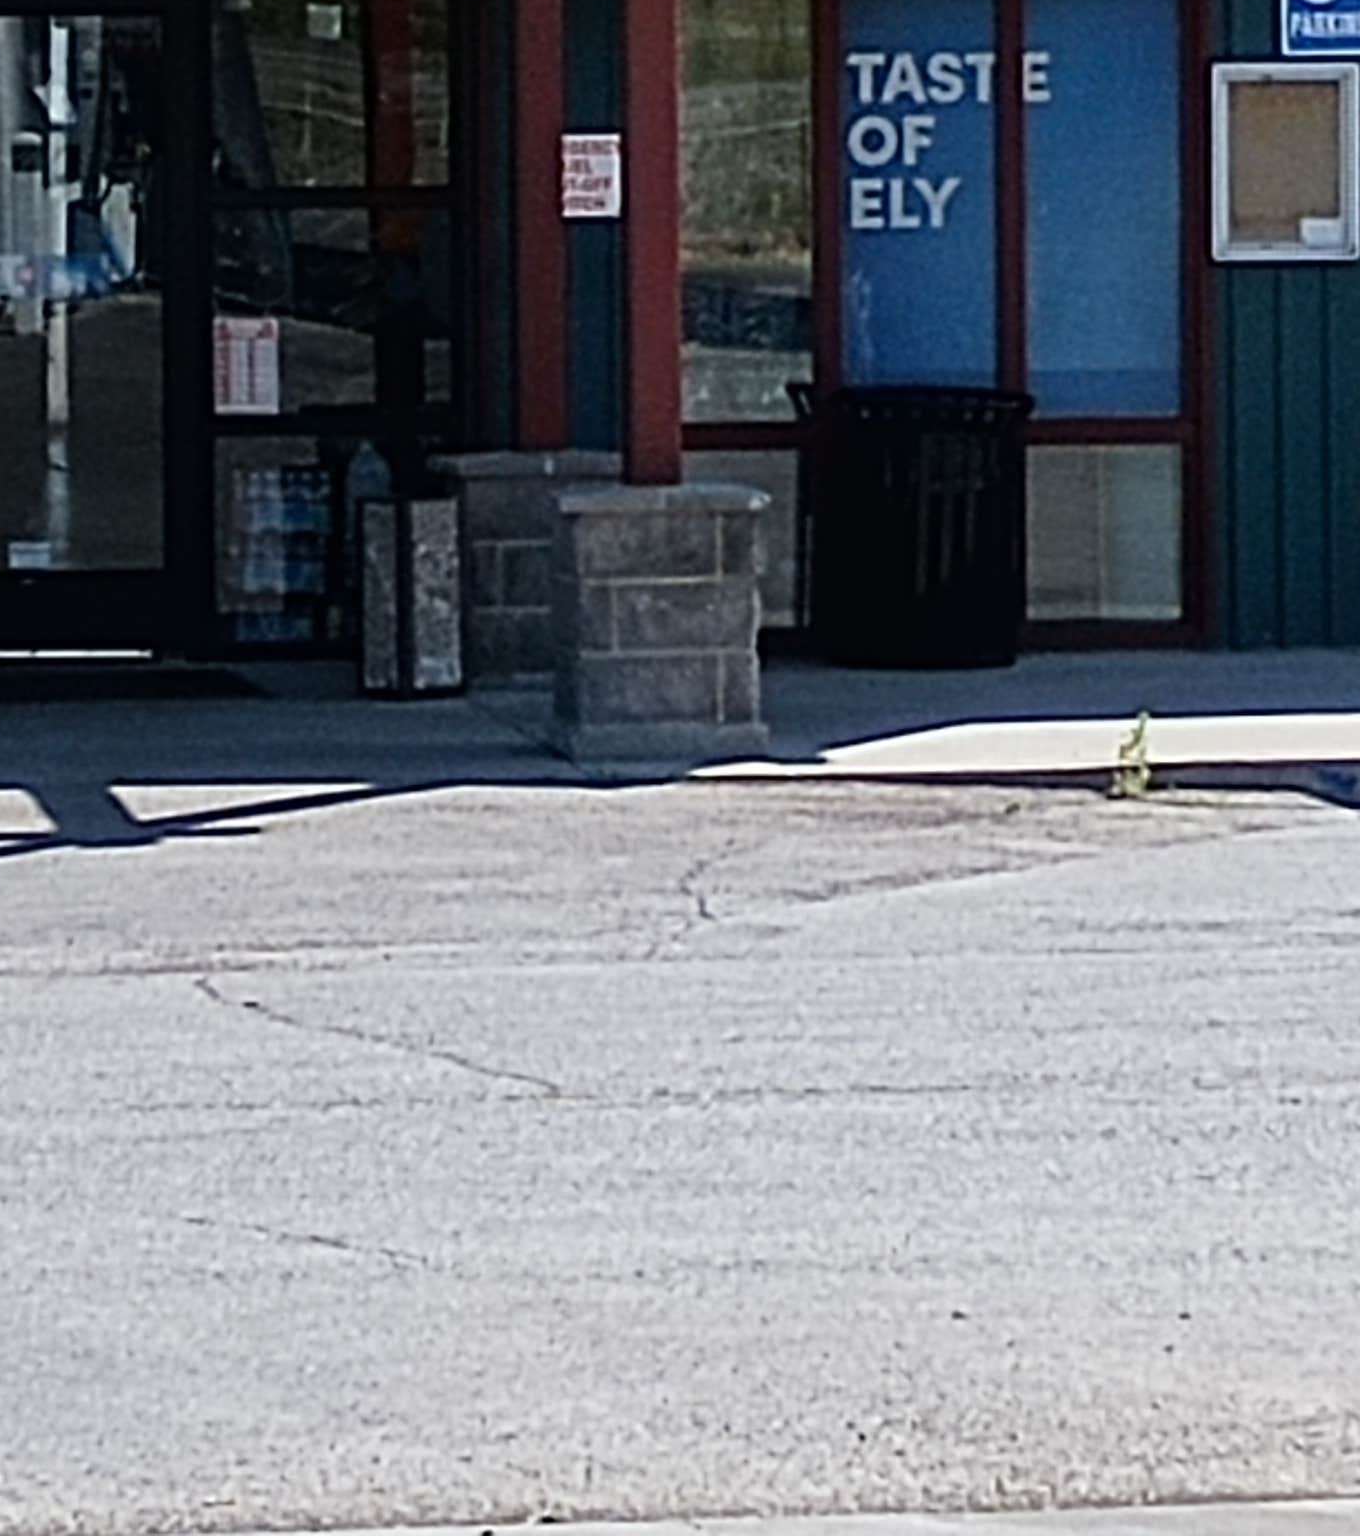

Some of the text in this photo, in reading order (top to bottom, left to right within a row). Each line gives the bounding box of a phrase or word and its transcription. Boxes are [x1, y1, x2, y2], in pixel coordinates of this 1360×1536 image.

[846, 52, 1051, 104] TASTE
[847, 115, 935, 166] OF
[850, 177, 961, 229] ELY
